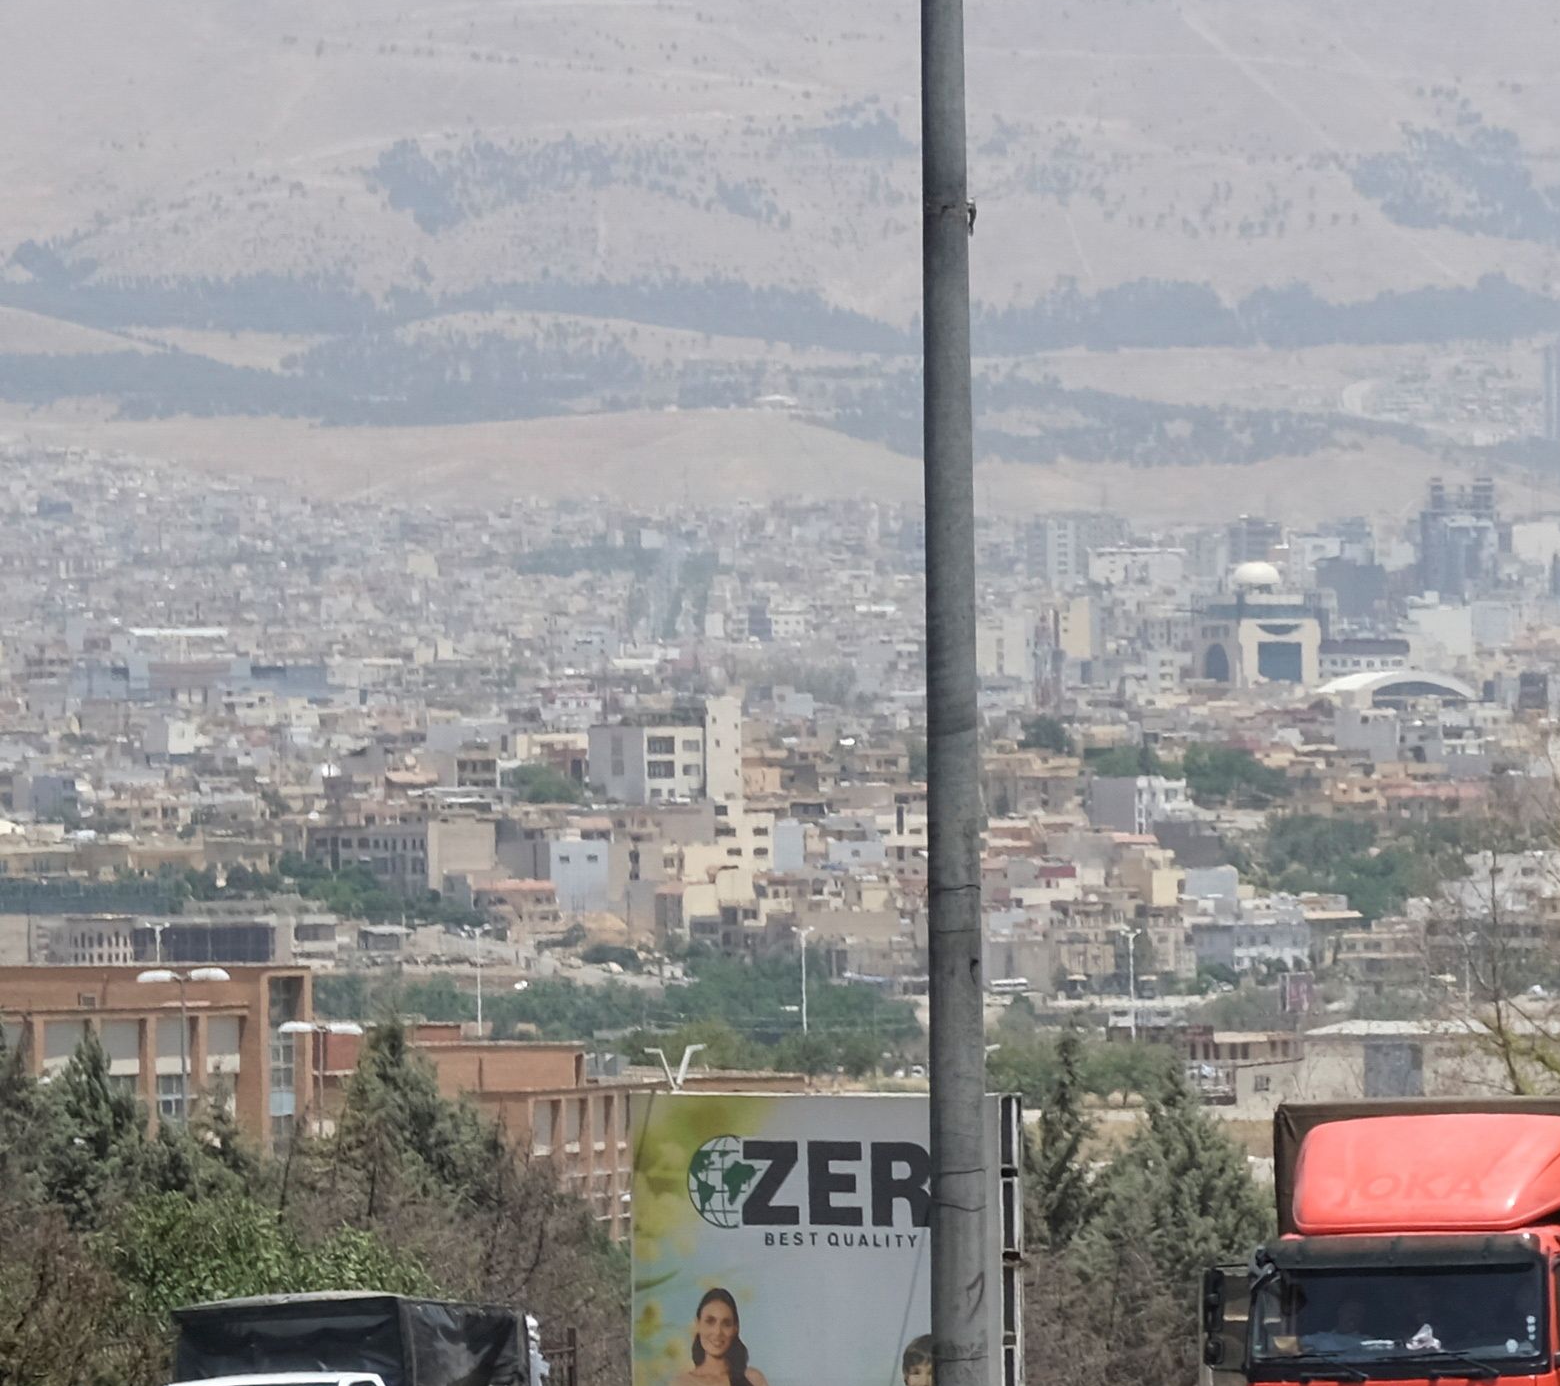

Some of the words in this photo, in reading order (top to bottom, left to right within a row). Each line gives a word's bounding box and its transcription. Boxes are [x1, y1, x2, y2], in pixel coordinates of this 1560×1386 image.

[742, 1139, 931, 1229] ZER
[764, 1232, 819, 1247] BEST
[827, 1232, 919, 1249] QUALITY
